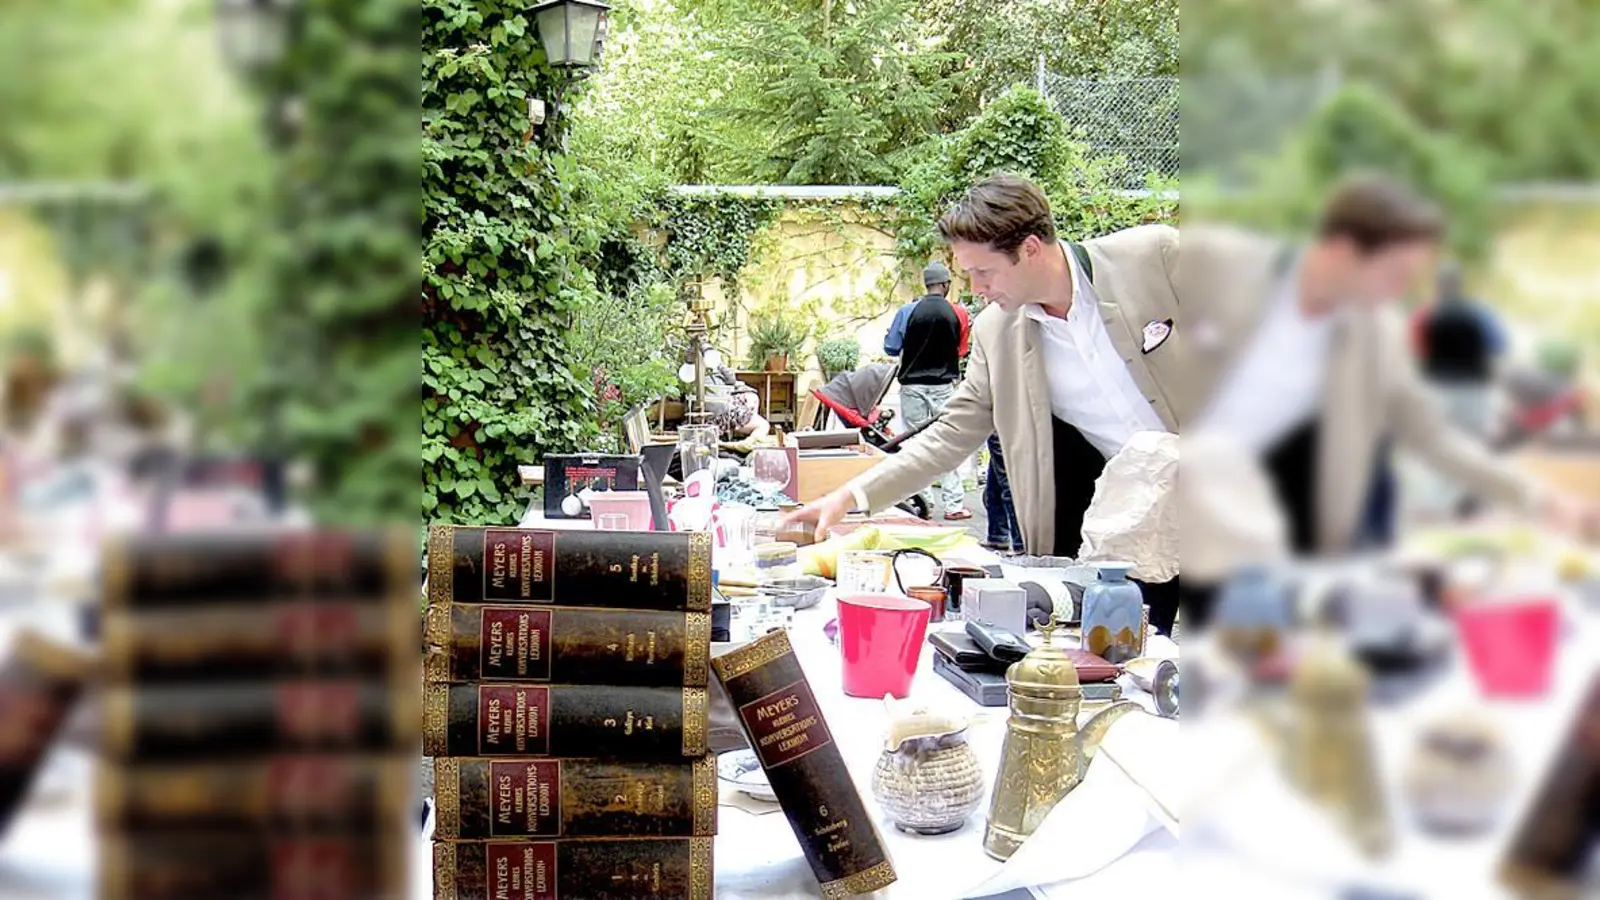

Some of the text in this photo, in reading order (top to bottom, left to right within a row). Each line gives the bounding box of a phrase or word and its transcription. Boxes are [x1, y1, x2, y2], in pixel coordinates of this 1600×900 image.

[492, 543, 506, 588] MEYERS
[533, 550, 543, 582] LEXIKON
[609, 564, 622, 572] 5
[489, 621, 503, 667] MEYERS
[530, 629, 540, 660] LEXIKON
[607, 643, 619, 651] 4
[486, 699, 500, 744] MEYERS
[528, 706, 539, 738] LEXIKON
[604, 719, 616, 727] 3
[756, 695, 800, 721] MEYERS
[778, 733, 809, 752] LEXIKON
[499, 775, 511, 824] MEYERS
[539, 782, 550, 816] LEXIKON
[819, 805, 828, 817] 6
[496, 856, 508, 900] MEYERS
